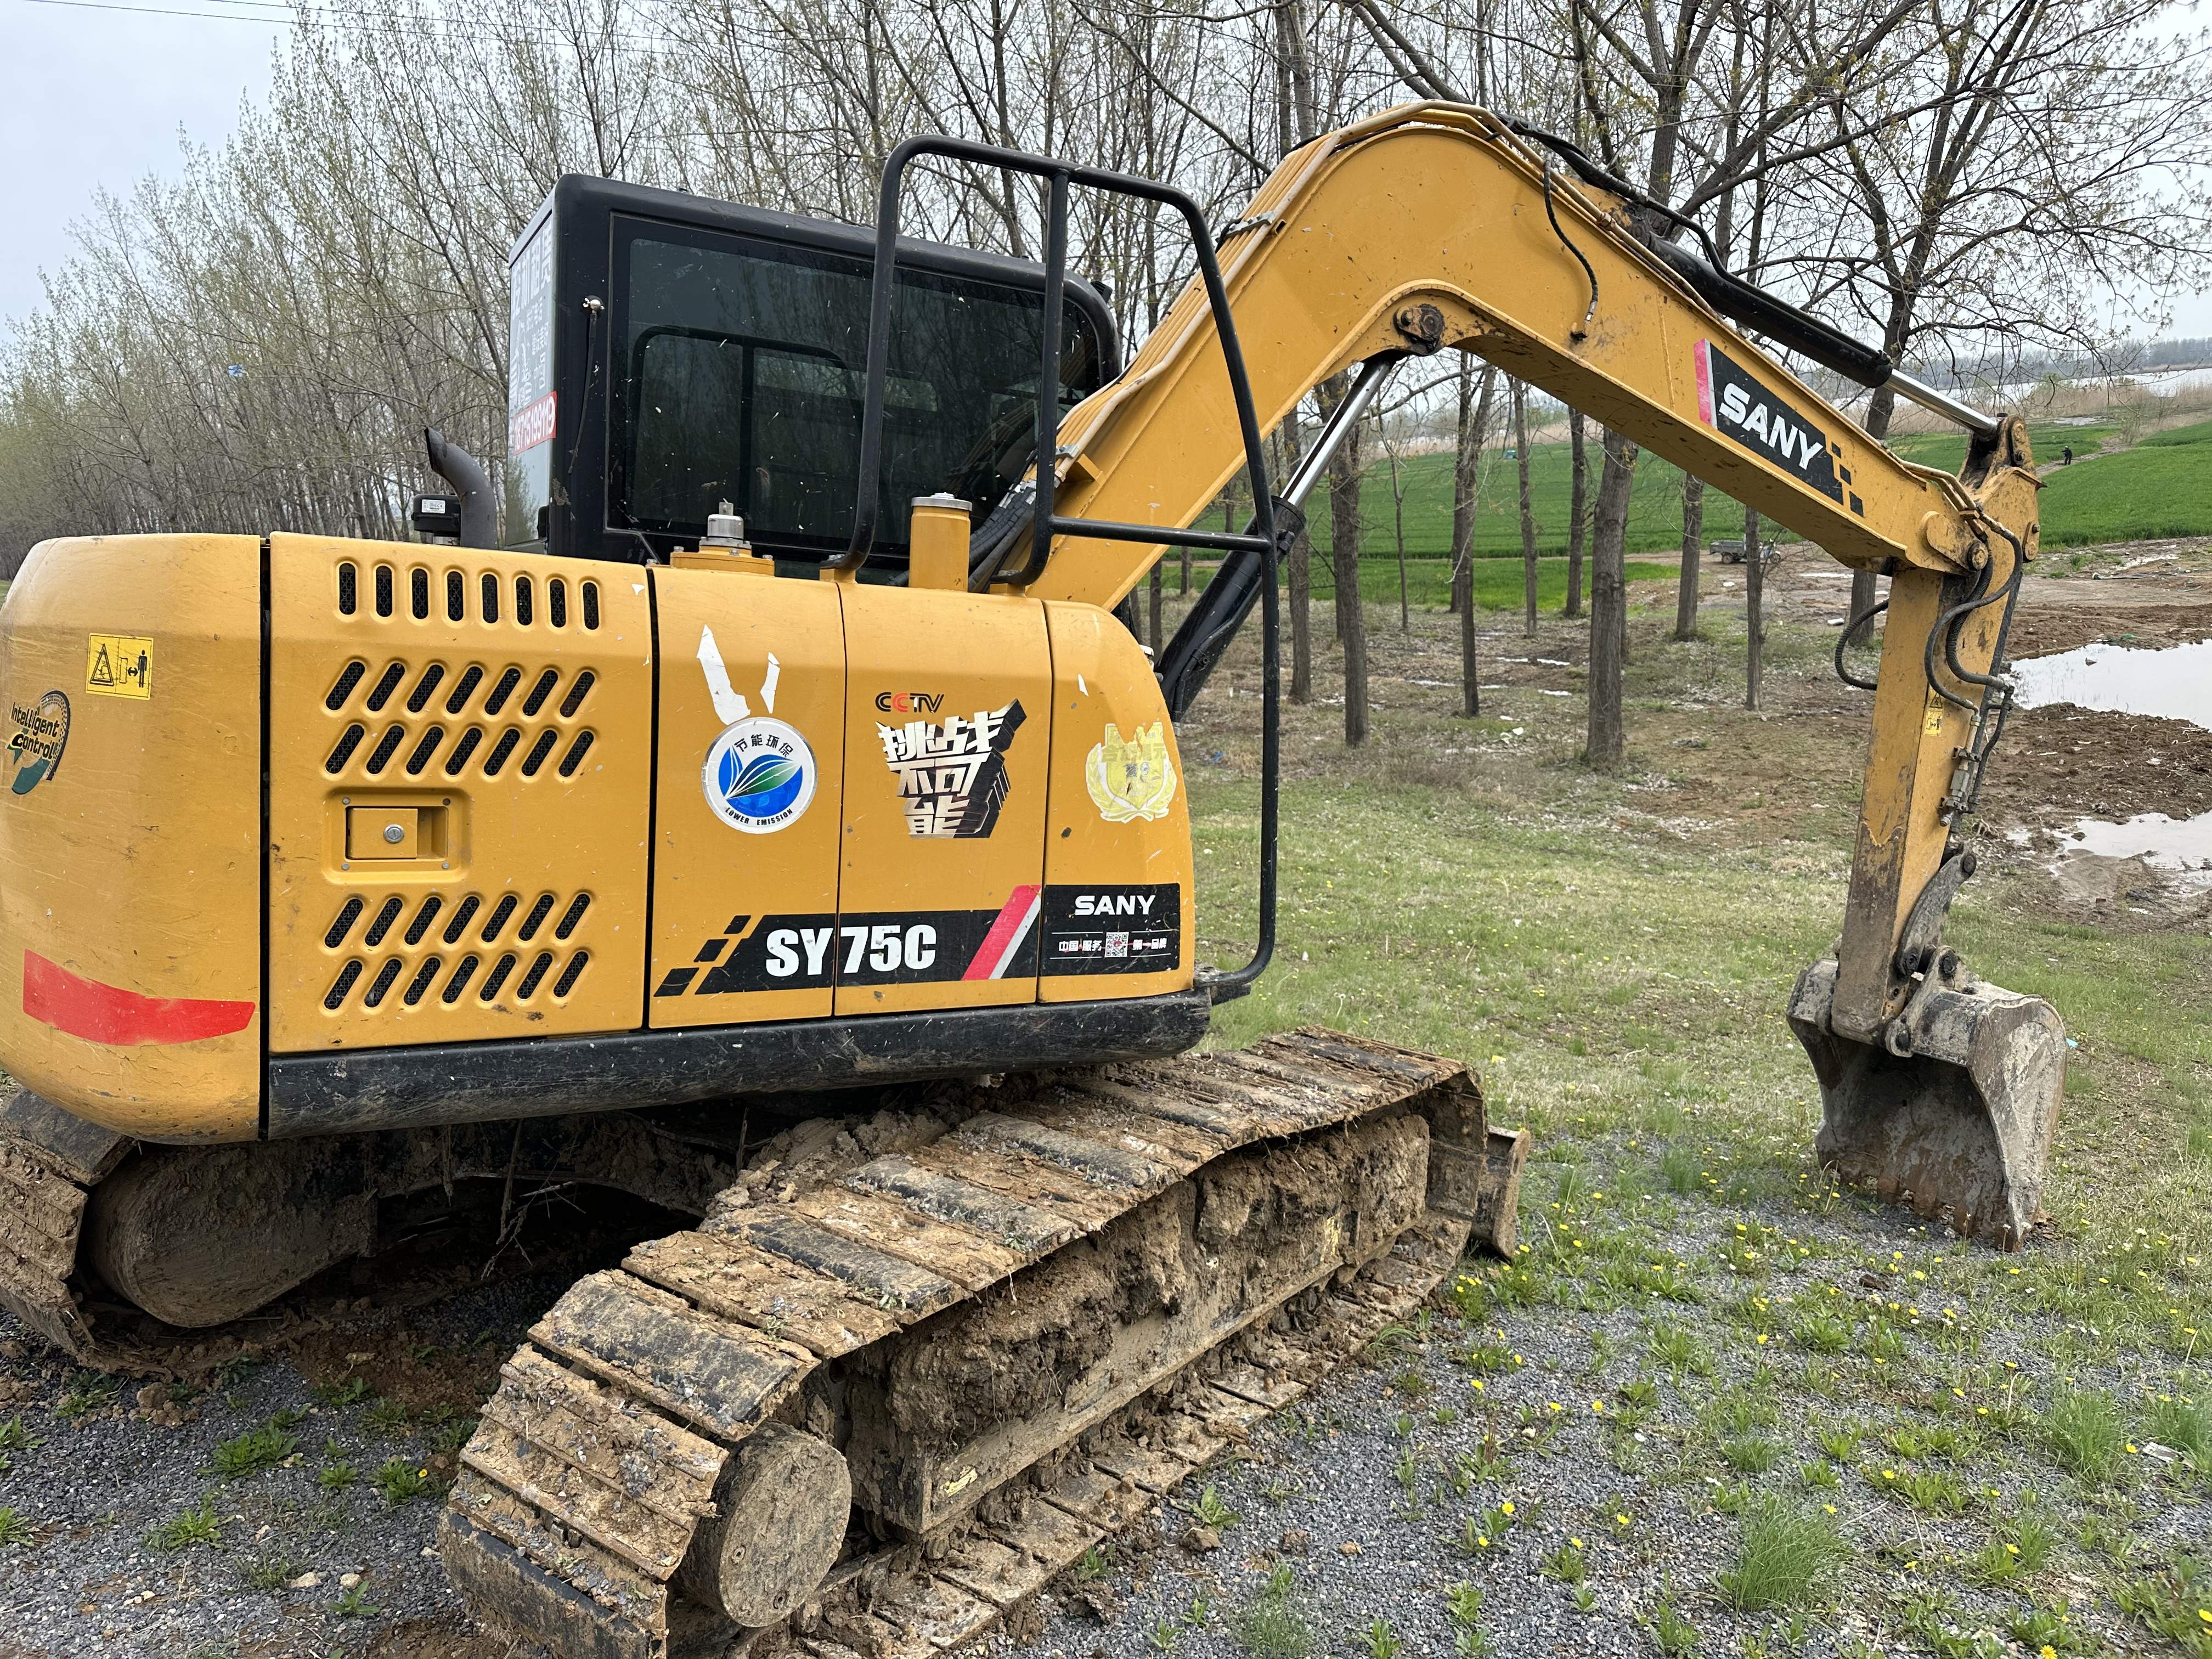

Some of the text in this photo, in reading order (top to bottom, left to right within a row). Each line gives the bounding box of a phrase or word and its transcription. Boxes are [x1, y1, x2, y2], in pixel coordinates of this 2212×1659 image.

[514, 396, 555, 452] 18715199119
[1719, 383, 1824, 470] SANY
[11, 702, 59, 737] Intelligent
[875, 691, 944, 713] CCTV
[733, 733, 794, 758] 节能环保
[876, 698, 1018, 762] 挑战
[887, 752, 991, 797] 不可
[725, 807, 793, 826] LOWER EMISSION
[902, 795, 970, 838] 能
[1075, 895, 1156, 916] SANY
[766, 924, 936, 977] SY75C
